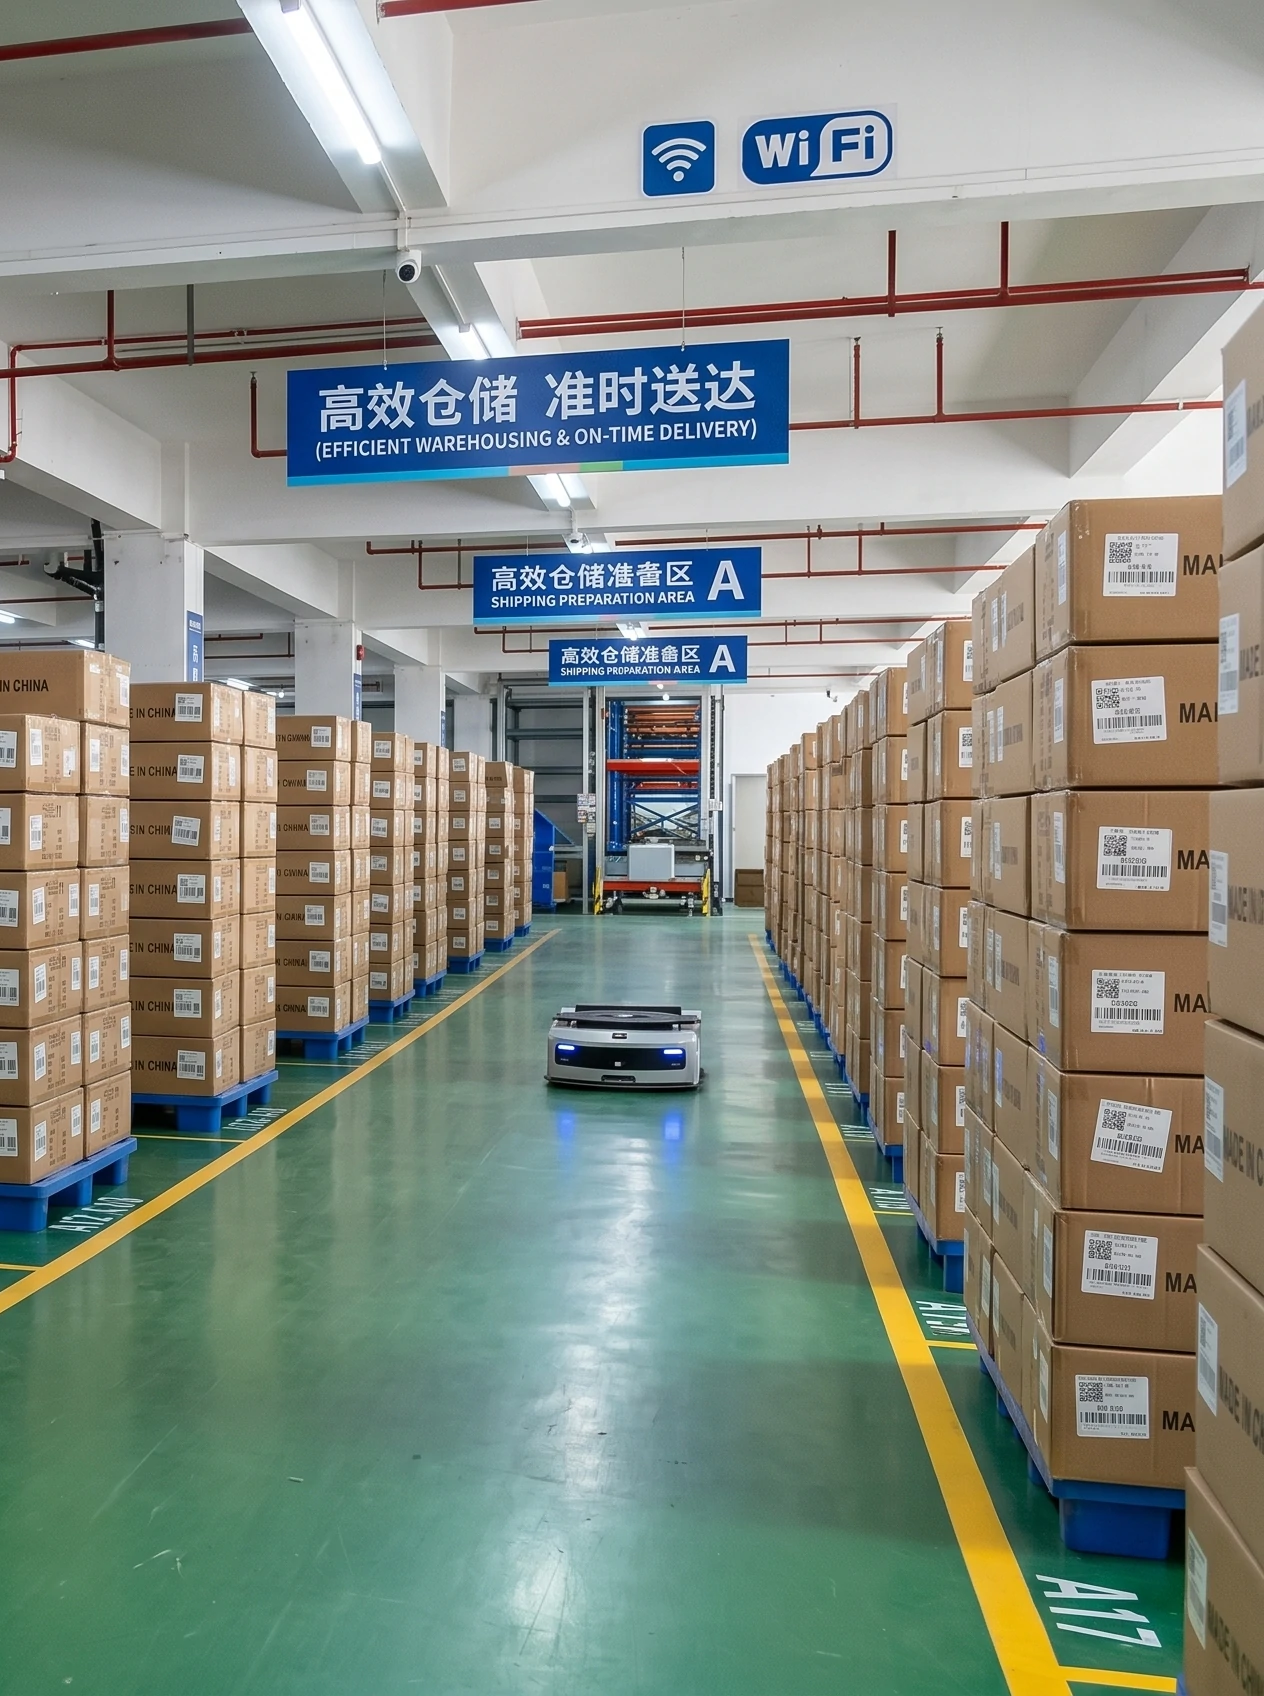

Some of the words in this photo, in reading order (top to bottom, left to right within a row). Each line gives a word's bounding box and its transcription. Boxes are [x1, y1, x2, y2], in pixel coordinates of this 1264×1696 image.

[318, 374, 518, 433] 高效仓储
[544, 361, 756, 420] 准时送达
[315, 437, 411, 462] (EFFICIENT
[416, 430, 551, 453] WAREHOUSING
[556, 429, 570, 446] &
[574, 424, 654, 444] ON-TIME
[660, 418, 756, 440] DELIVERY)
[1183, 554, 1222, 576] MA
[707, 560, 745, 601] A
[491, 594, 556, 608] SHIPPING
[559, 592, 655, 606] PREPARATION
[658, 591, 695, 604] AREA
[708, 644, 736, 673] A
[560, 667, 605, 676] SHIPPING
[673, 664, 701, 674] AREA
[0, 679, 11, 693] IN
[13, 678, 49, 692] CHINA
[136, 707, 146, 719] IN
[1179, 702, 1218, 724] MA
[137, 766, 146, 777] IN
[148, 765, 178, 778] CHINA
[1177, 849, 1209, 870] MA
[135, 883, 145, 895] IN
[147, 883, 178, 896] CHINA
[135, 942, 144, 953] IN
[135, 1000, 145, 1012] IN
[147, 1000, 175, 1012] CHIN
[1173, 993, 1207, 1013] MA
[134, 1059, 145, 1071] IN
[147, 1060, 178, 1072] CHINA
[1174, 1134, 1204, 1154] MA
[1165, 1271, 1198, 1294] MA
[1162, 1410, 1195, 1433] MA
[1035, 1573, 1162, 1648] A17
